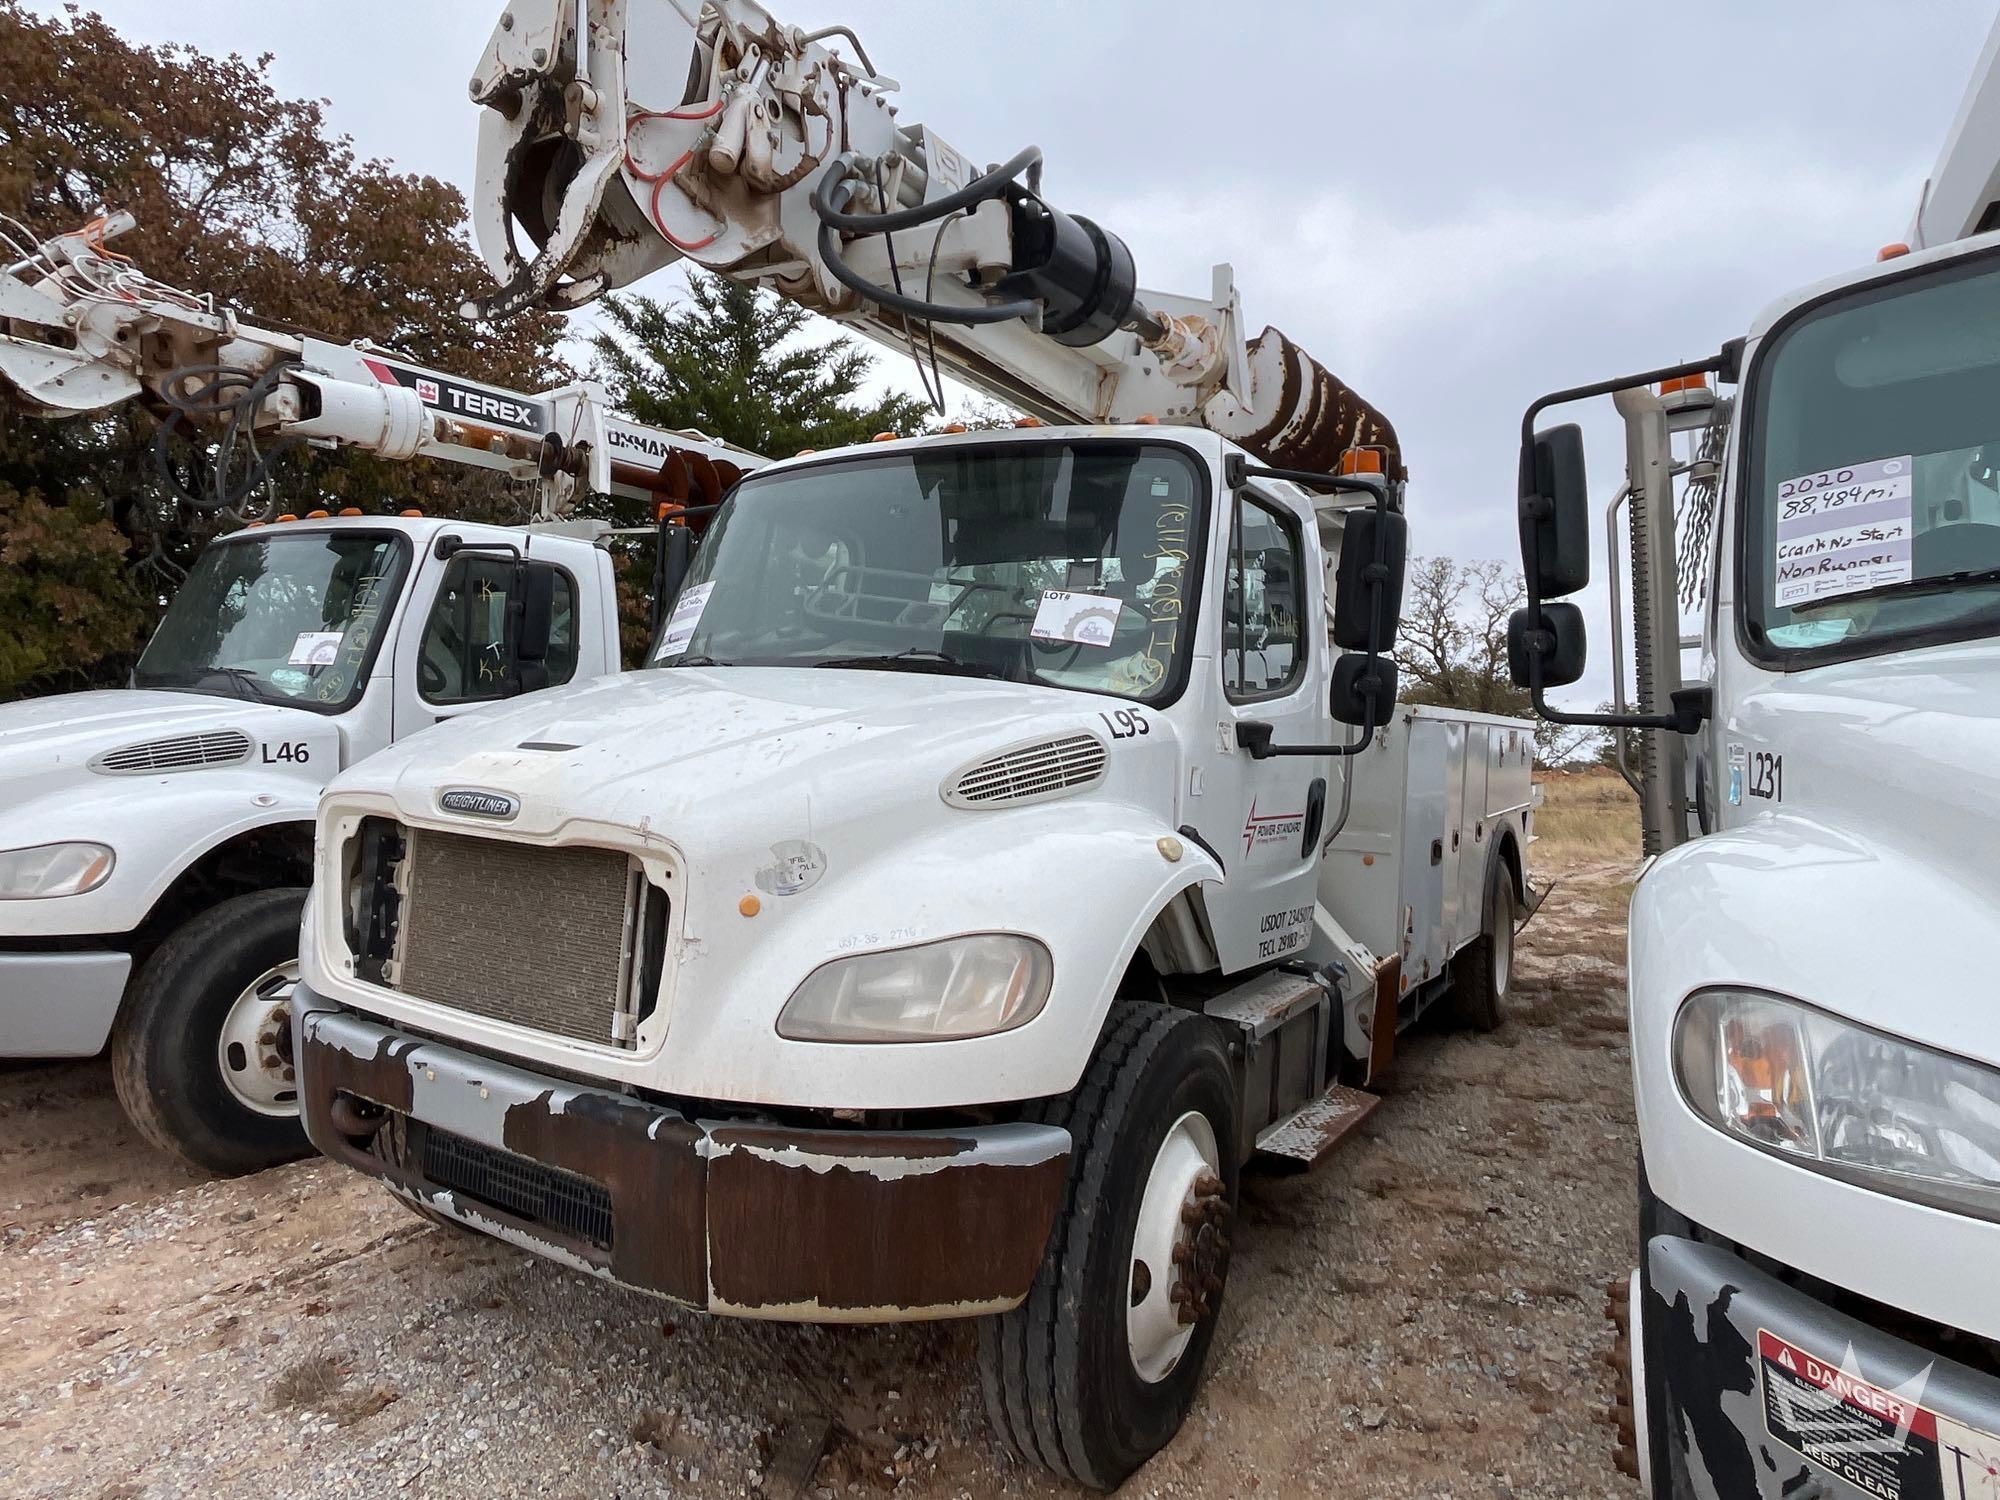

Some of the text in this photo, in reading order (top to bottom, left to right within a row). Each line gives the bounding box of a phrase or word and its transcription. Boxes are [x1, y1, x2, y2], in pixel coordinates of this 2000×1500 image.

[448, 387, 533, 427] TEREX
[1782, 470, 1853, 498] 2020
[1044, 592, 1070, 601] LOT#
[1098, 707, 1150, 739] L95
[262, 742, 310, 763] L46
[1748, 751, 1782, 803] L231
[444, 794, 509, 812] FREIGHTLINER
[1261, 911, 1287, 933] USDOT
[1806, 1360, 1906, 1425] DANGER
[1845, 1404, 1882, 1428] HAZARD
[1801, 1440, 1899, 1500] KEEP CLEAR
